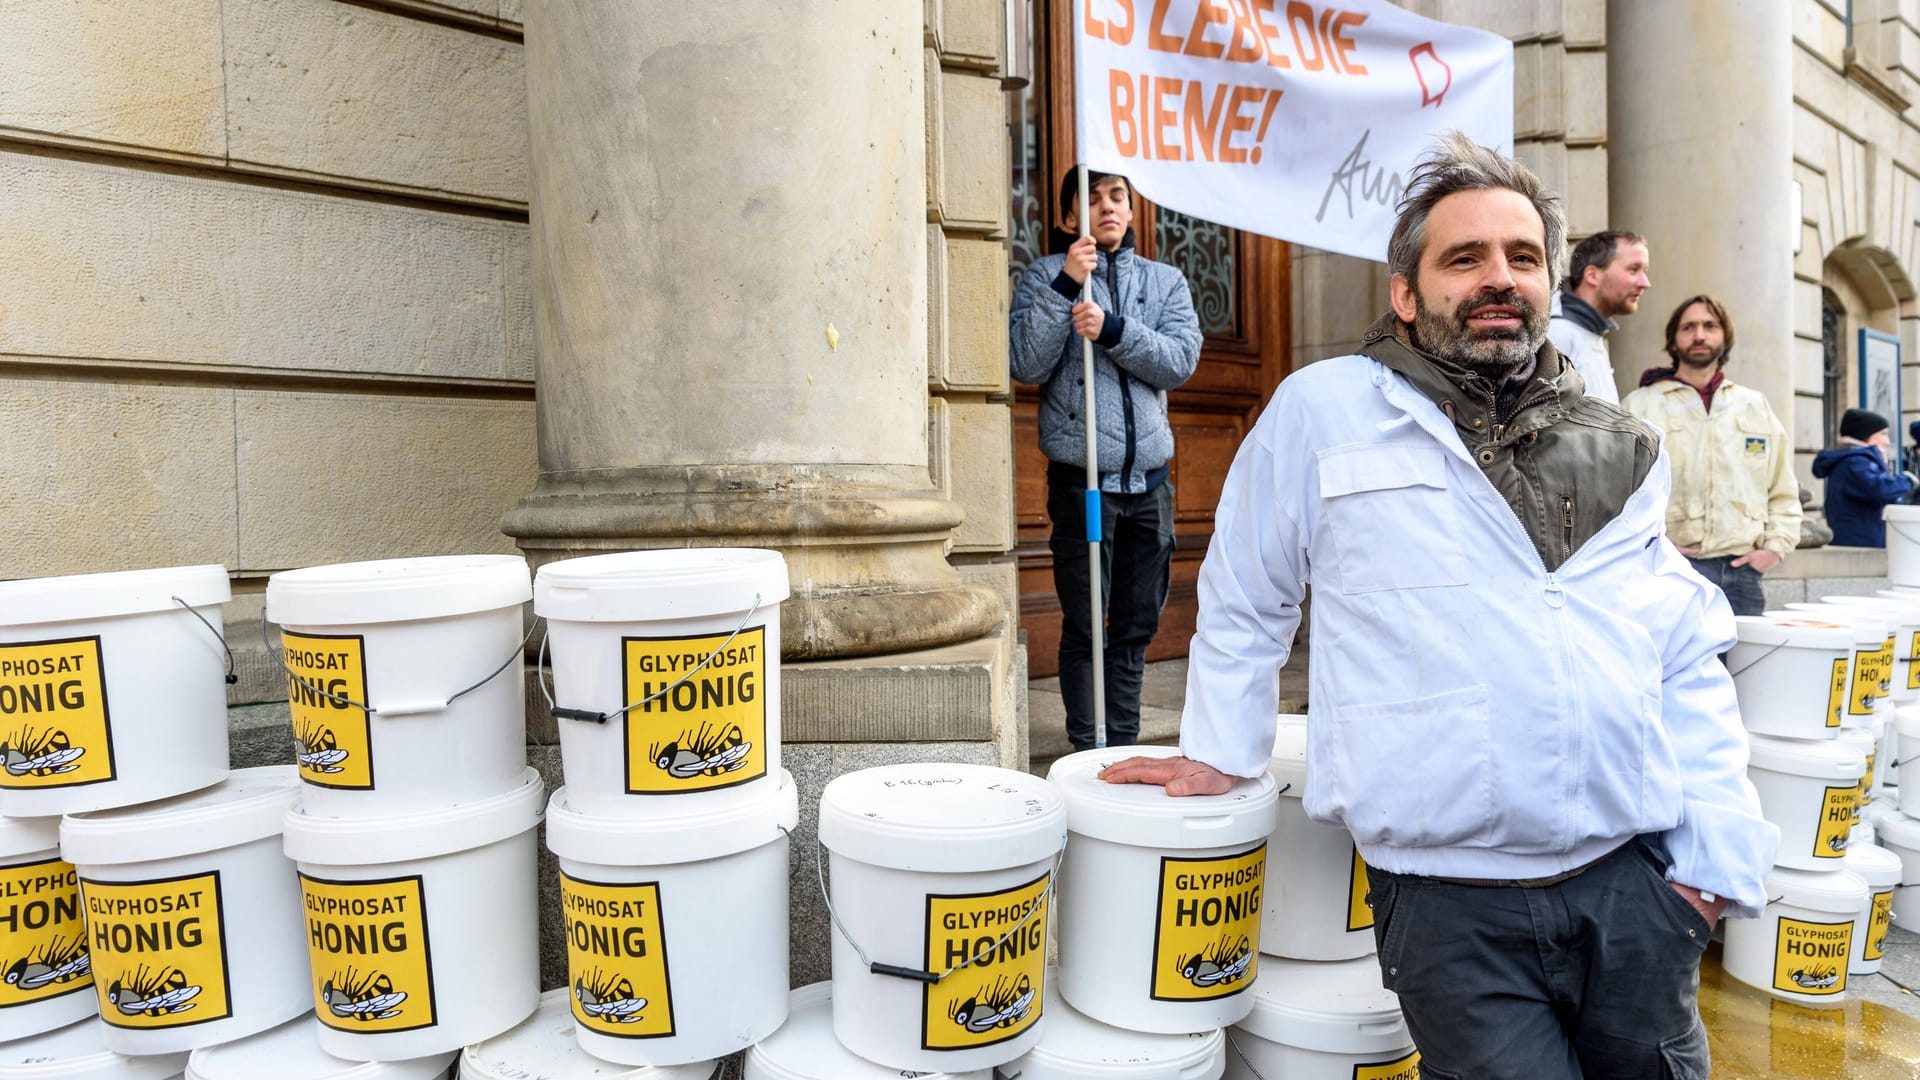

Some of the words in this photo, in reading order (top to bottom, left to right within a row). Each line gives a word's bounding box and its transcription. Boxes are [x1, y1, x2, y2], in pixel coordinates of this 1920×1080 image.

[1148, 0, 1291, 68] LEBE
[1287, 1, 1370, 75] DIE
[1109, 68, 1284, 165] BIENE!
[640, 645, 756, 672] GLYPHOSAT
[0, 680, 85, 714] ONIG
[644, 672, 754, 712] HONIG
[0, 870, 77, 898] LYPHO
[1176, 861, 1263, 890] GLYPHOSAT
[0, 894, 83, 932] HON
[90, 892, 202, 915] GLYPHOSAT
[306, 892, 406, 915] GLYPHOSAT
[563, 888, 644, 918] GLYPHOSAT
[943, 892, 1043, 930] GLYPHOSAT
[1176, 885, 1259, 926] HONIG
[95, 917, 202, 953] HONIG
[310, 918, 407, 954] HONIG
[566, 913, 646, 957] HONIG
[945, 919, 1040, 969] HONIG
[1786, 926, 1849, 940] GLYPHOSAT
[1786, 940, 1846, 958] HONIG
